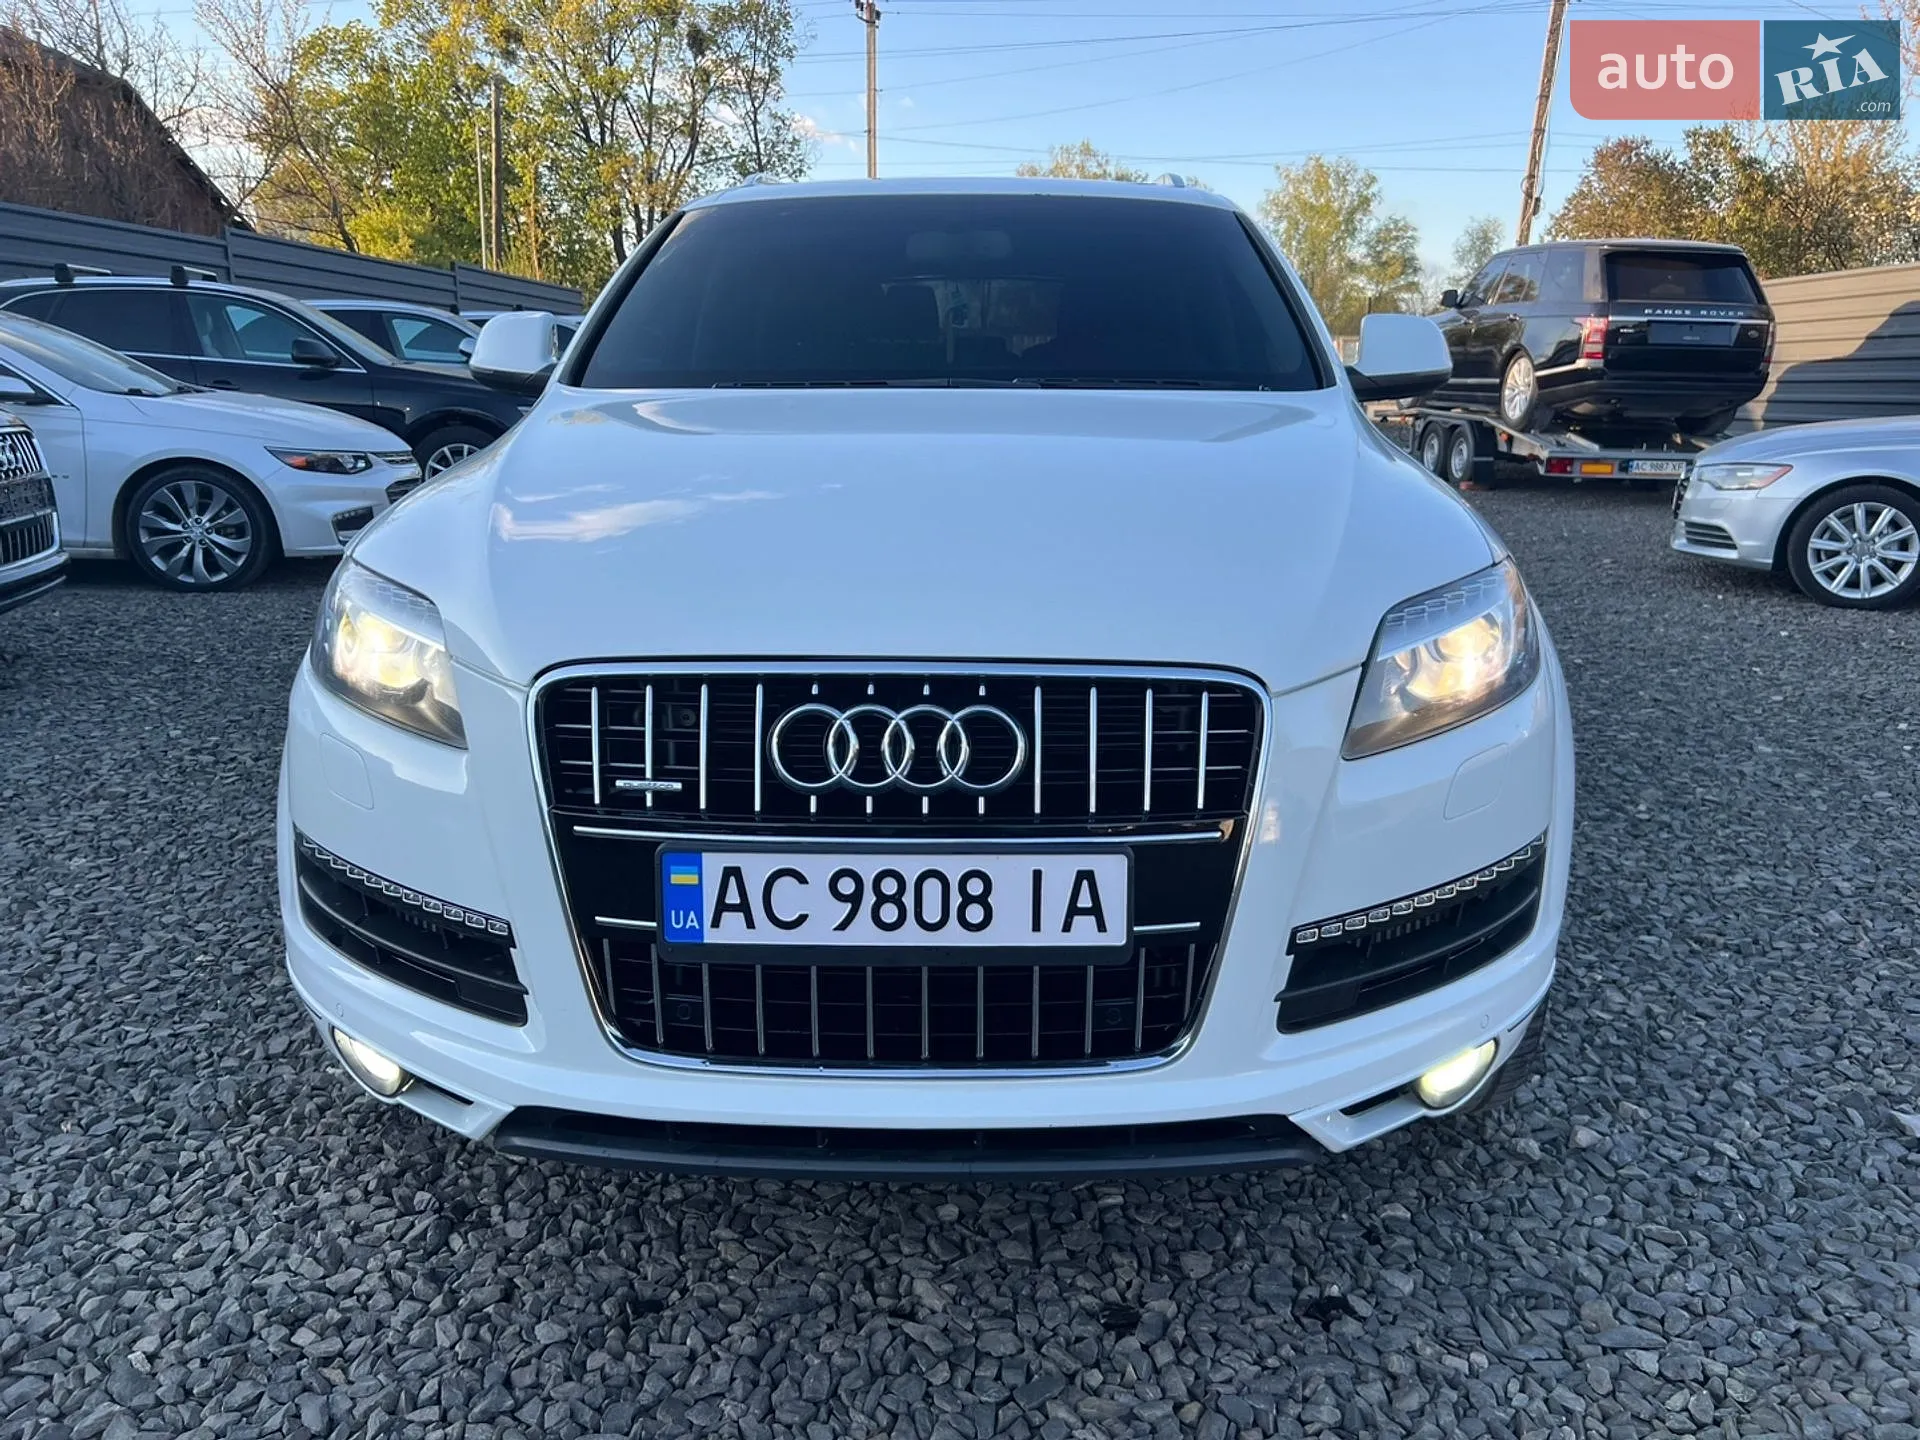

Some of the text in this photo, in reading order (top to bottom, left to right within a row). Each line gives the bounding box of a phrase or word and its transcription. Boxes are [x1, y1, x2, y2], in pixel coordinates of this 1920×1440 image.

[1700, 309, 1744, 317] ROVER
[709, 865, 1108, 934] AC 9808 IA
[670, 909, 700, 930] UA
